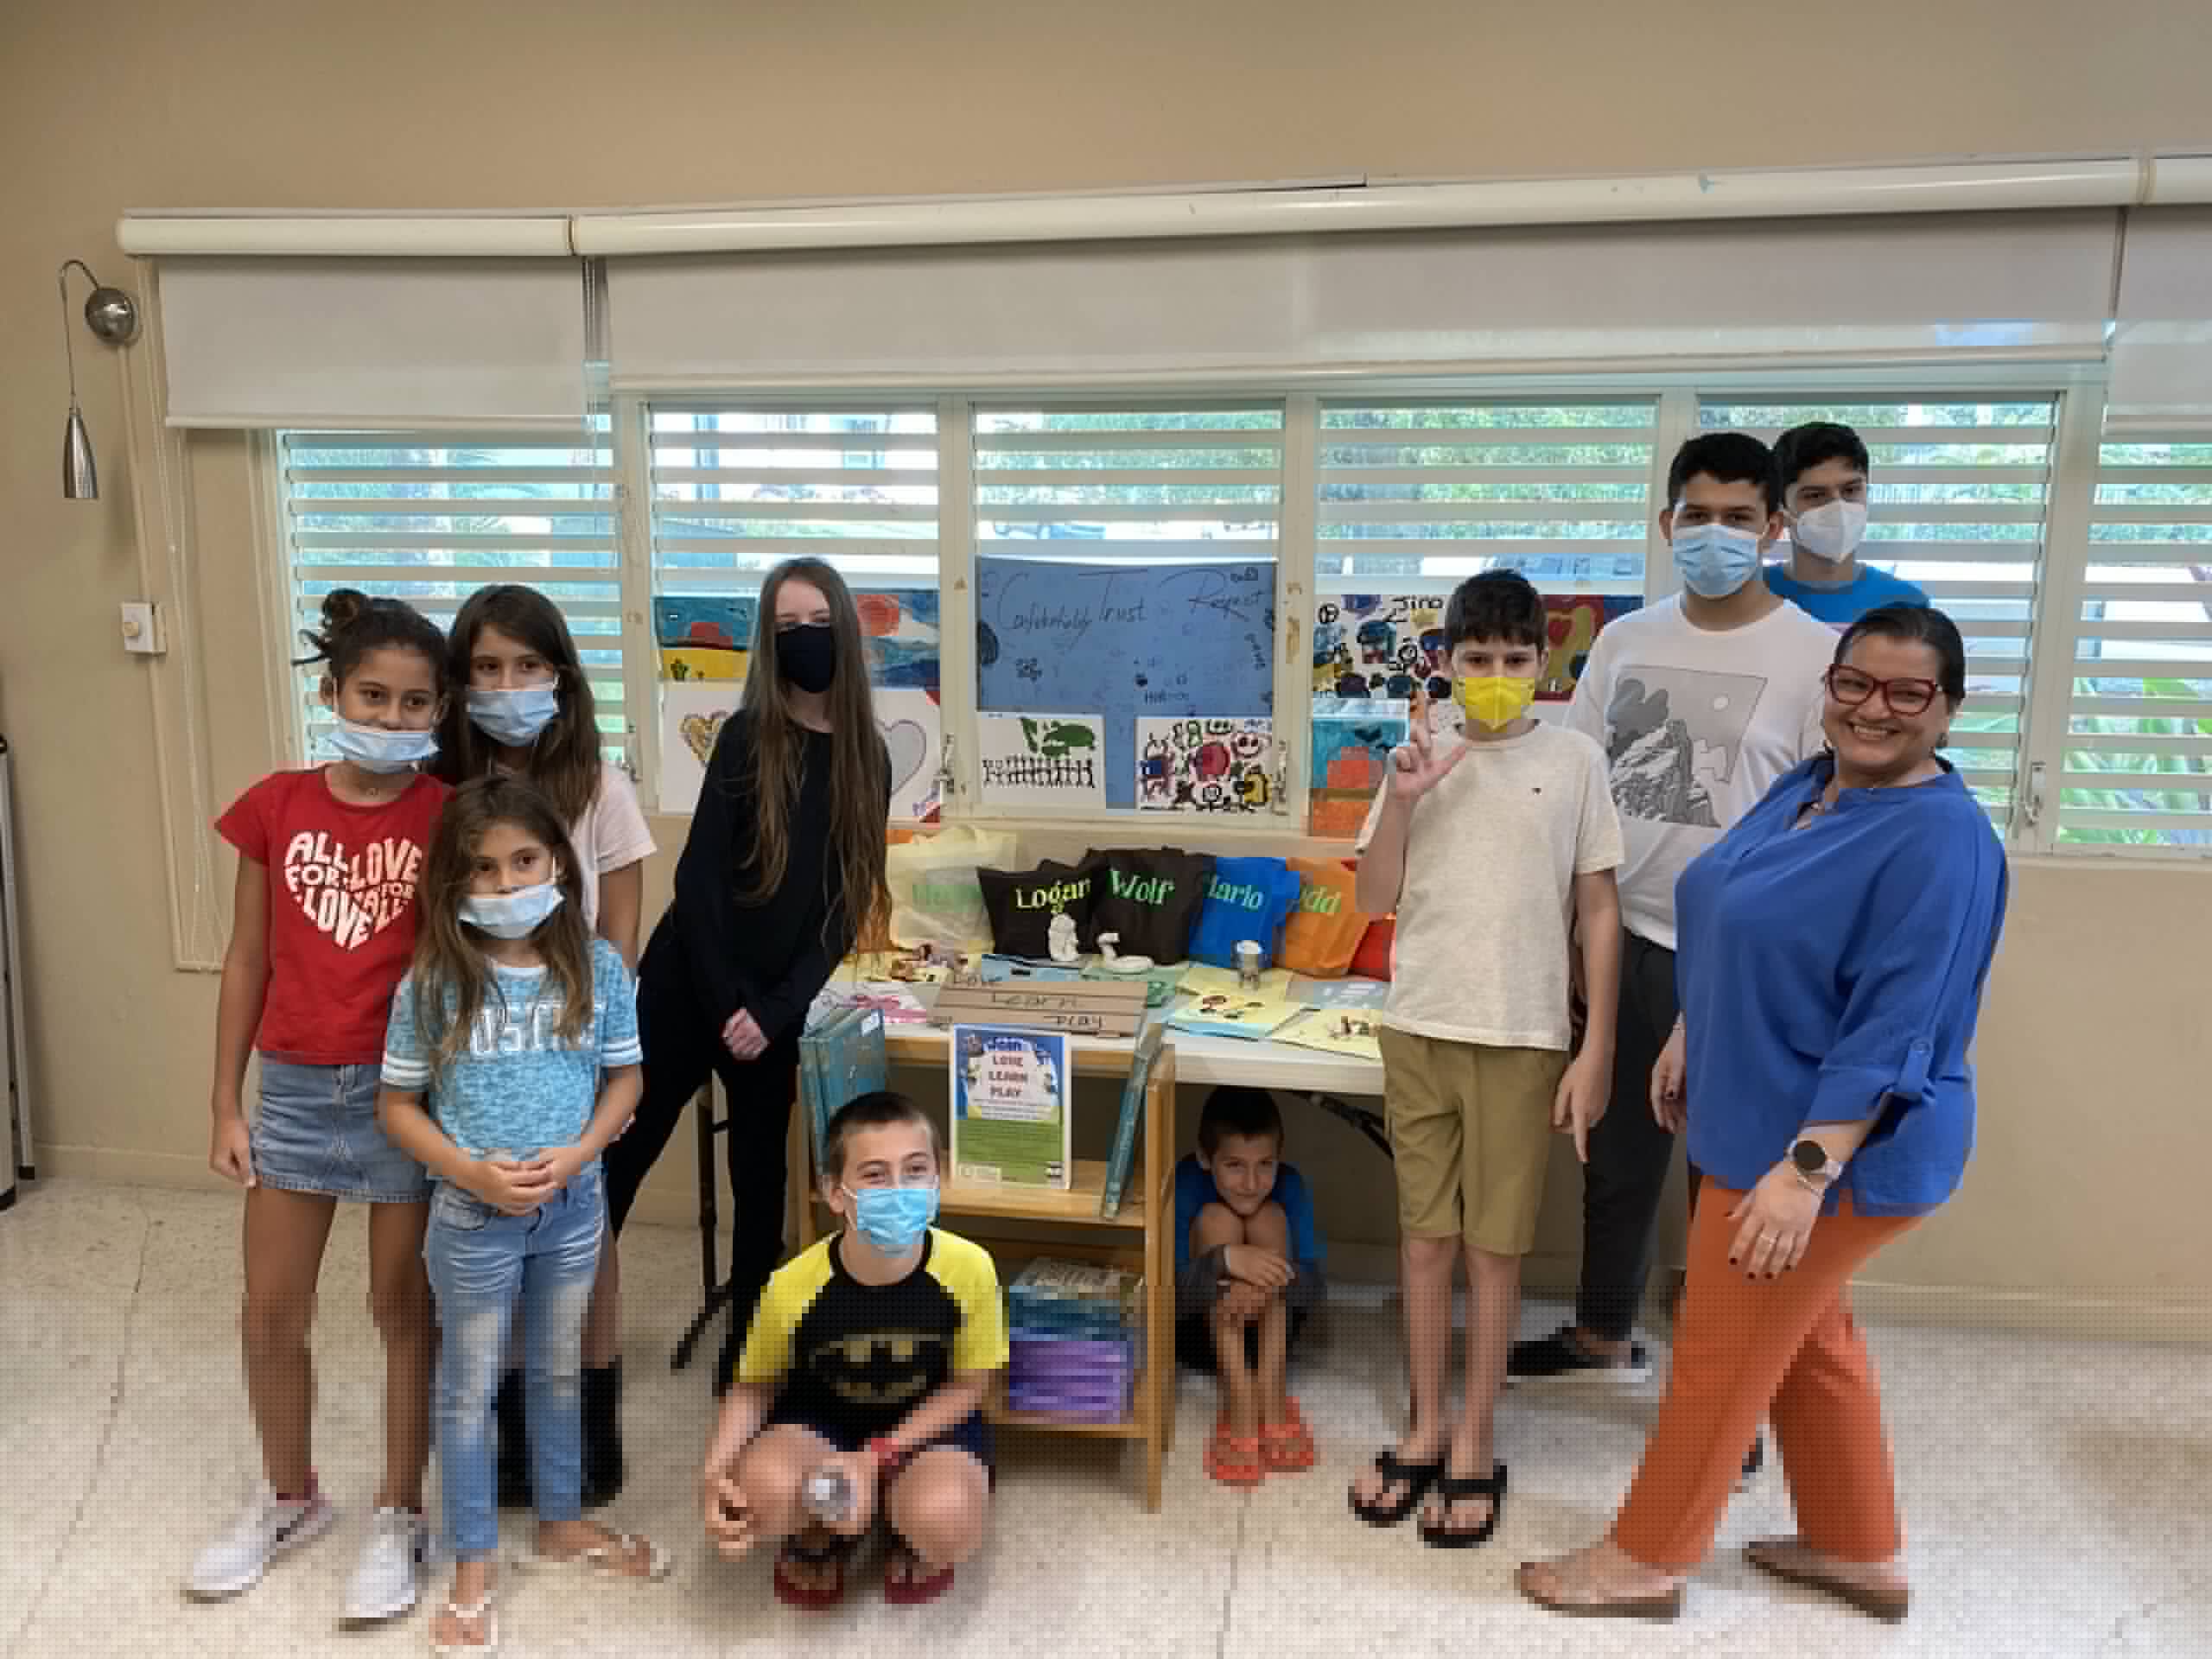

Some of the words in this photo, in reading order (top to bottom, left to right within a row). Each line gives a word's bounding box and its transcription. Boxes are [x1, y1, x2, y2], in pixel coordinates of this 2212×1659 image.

[1078, 569, 1147, 624] Trust
[284, 831, 348, 872] ALL
[350, 837, 423, 892] LOVE
[284, 865, 340, 892] FOR
[1015, 878, 1090, 914] Logan
[1111, 866, 1176, 906] Wolf
[302, 887, 373, 950] LOVE
[988, 1071, 1028, 1082] LEARN
[992, 1055, 1024, 1067] LOVE
[989, 1086, 1023, 1097] PLAY
